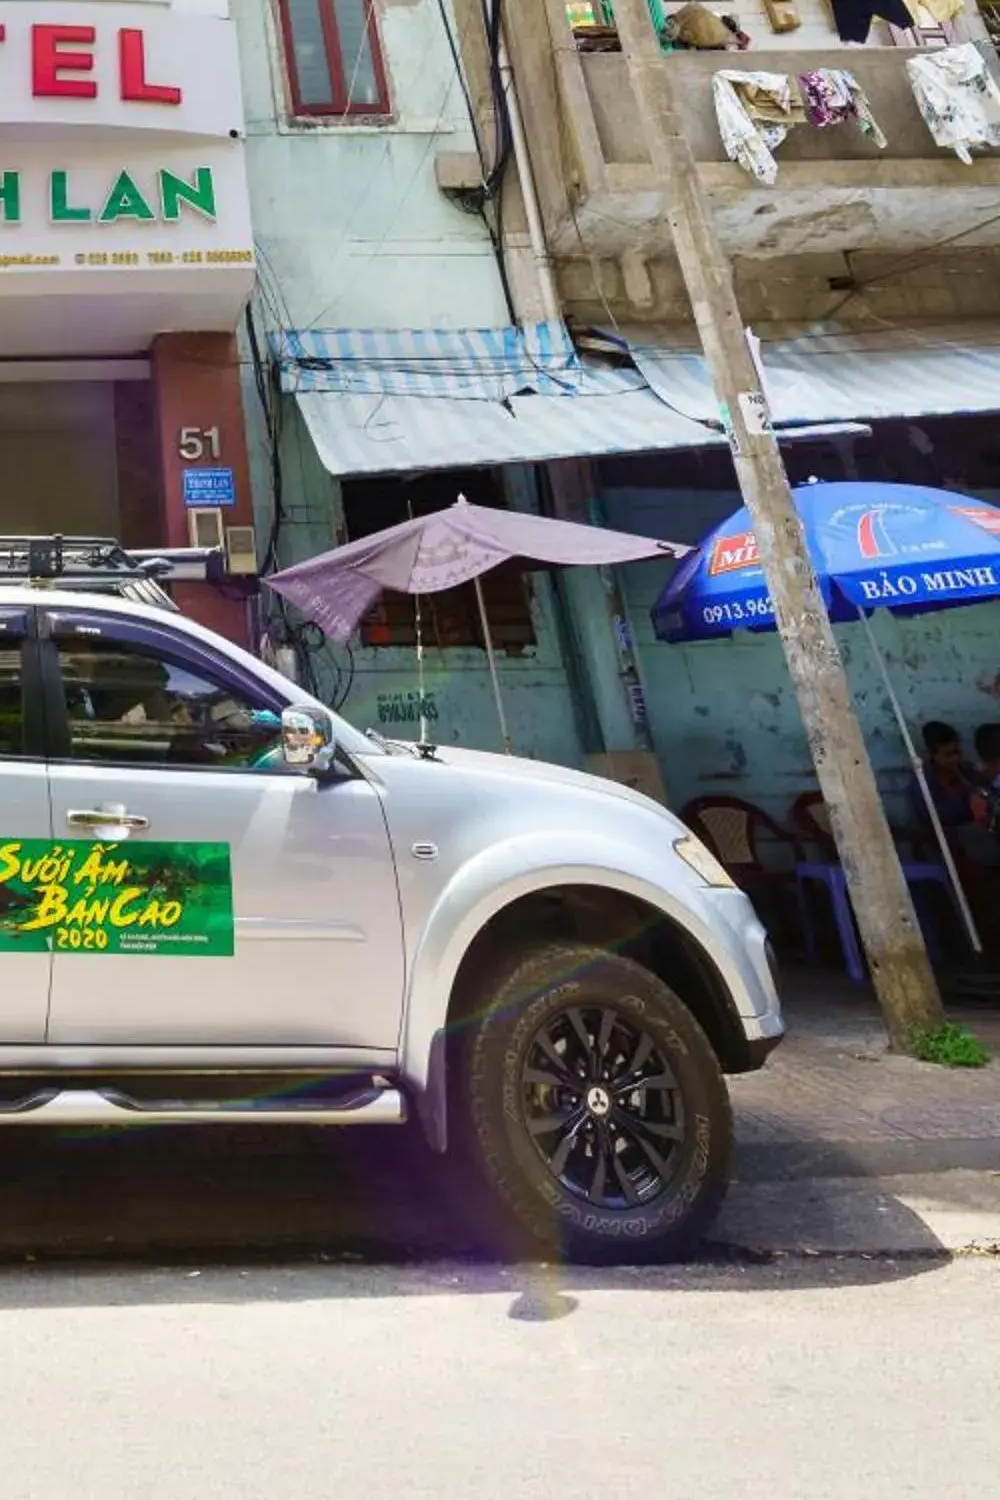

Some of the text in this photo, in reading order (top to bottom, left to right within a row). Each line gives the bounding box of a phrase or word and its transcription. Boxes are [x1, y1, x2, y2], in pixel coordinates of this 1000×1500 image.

[50, 166, 218, 224] LAN
[179, 425, 222, 460] 51
[861, 566, 999, 600] BẢO MINH
[110, 887, 183, 927] CAO
[56, 928, 110, 949] 2020
